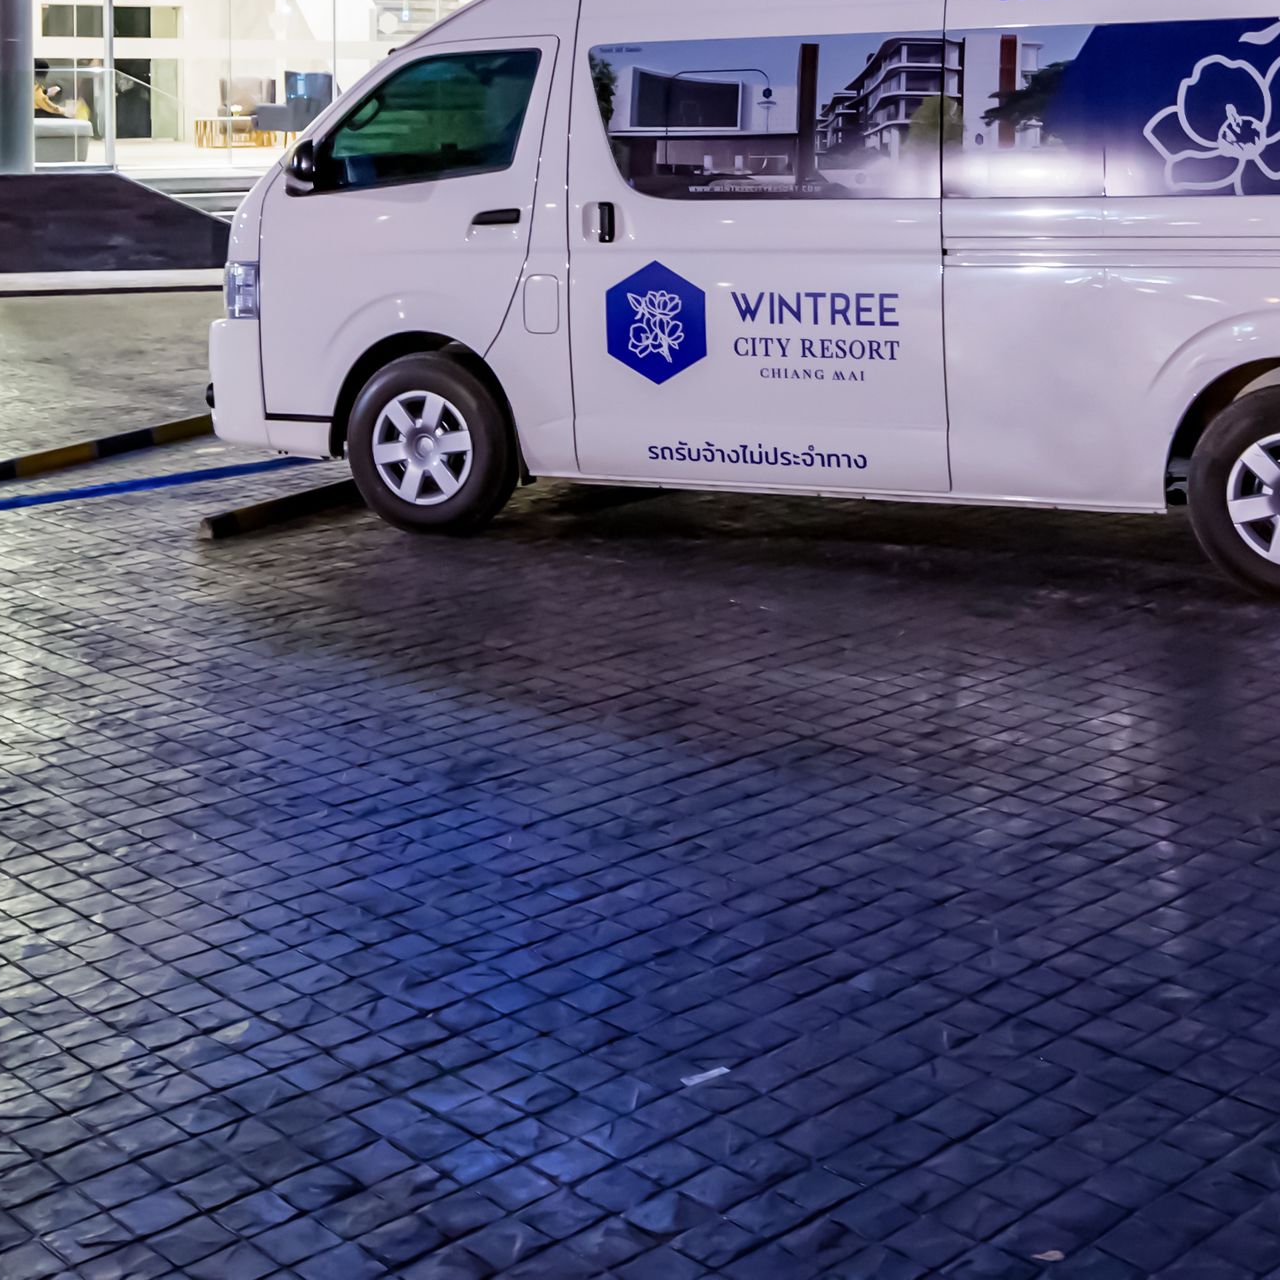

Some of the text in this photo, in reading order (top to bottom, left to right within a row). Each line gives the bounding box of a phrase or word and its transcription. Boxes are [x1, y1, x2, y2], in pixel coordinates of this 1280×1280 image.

[730, 291, 900, 327] WINTREE
[733, 336, 900, 361] CITY RESORT
[759, 367, 866, 382] CHIANG MAI
[647, 440, 868, 470] รถรับจ้างไม่ประจำทาง
